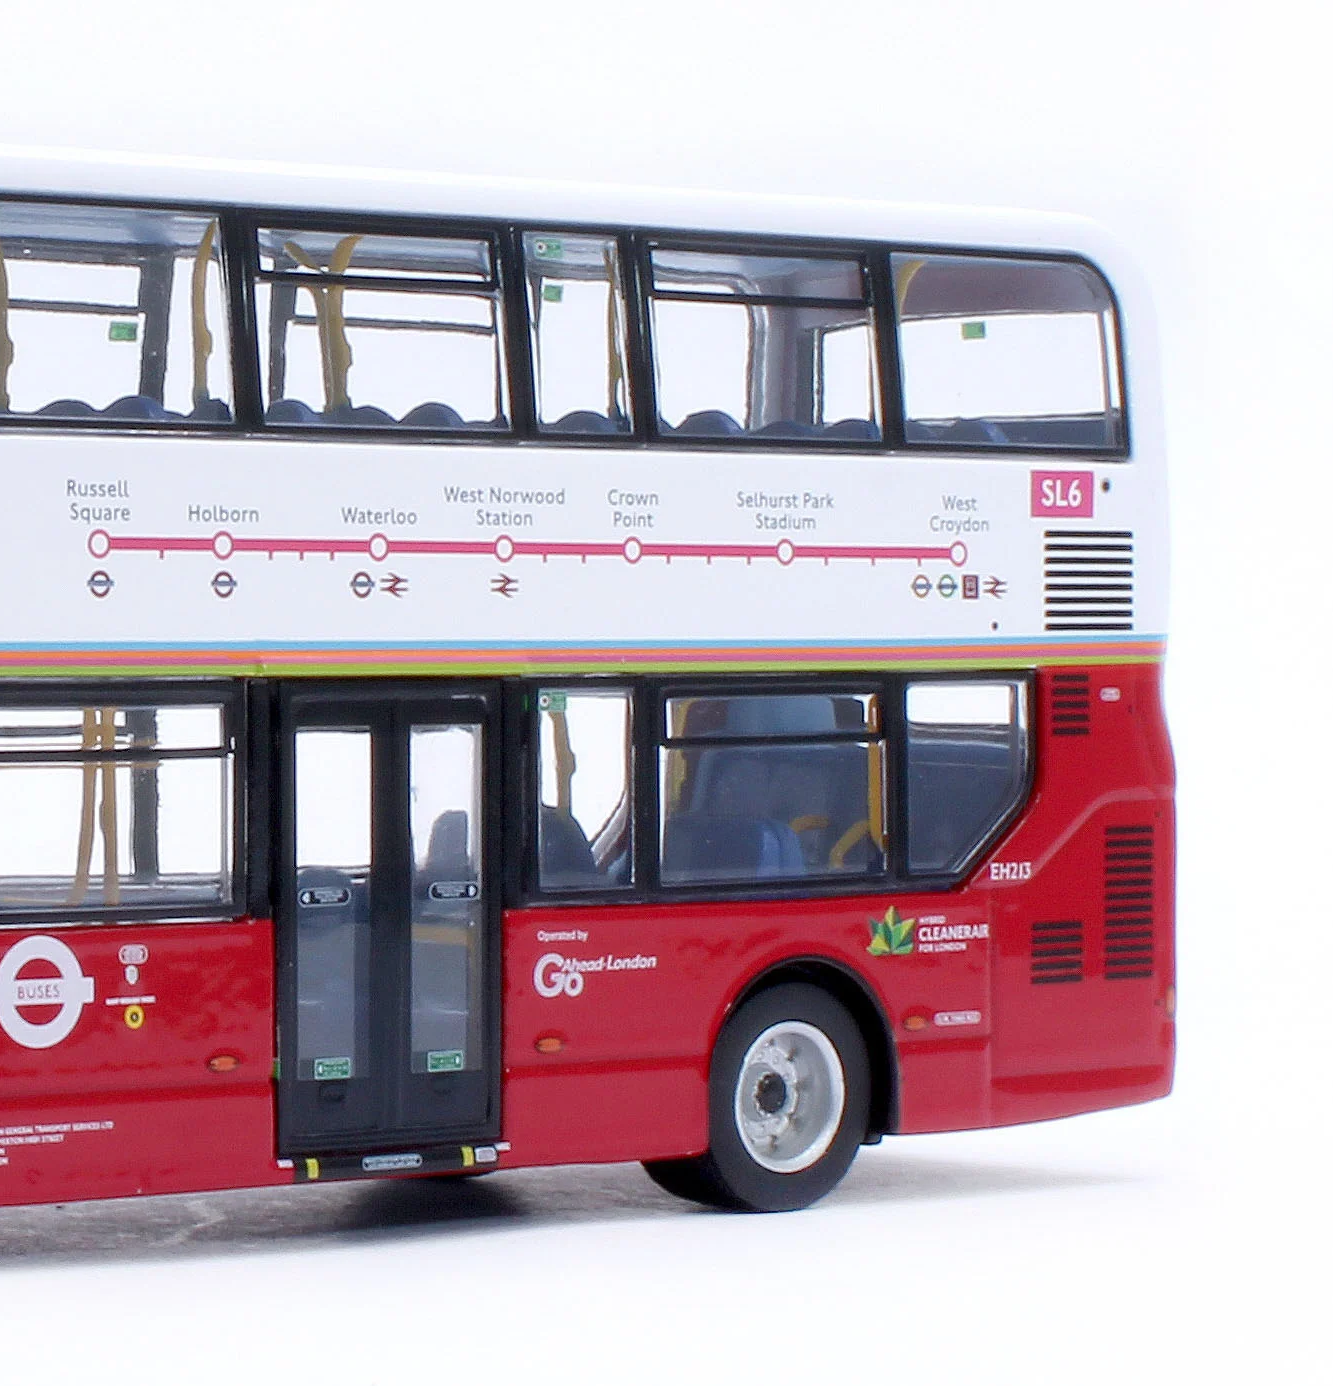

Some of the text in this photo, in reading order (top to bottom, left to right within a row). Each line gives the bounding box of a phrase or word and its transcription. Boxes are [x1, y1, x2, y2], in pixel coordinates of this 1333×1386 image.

[66, 480, 129, 498] Russell
[444, 486, 565, 505] West Norwood
[1041, 479, 1083, 508] SL6
[608, 490, 659, 508] Crown
[737, 491, 834, 509] Selhurst Park
[942, 495, 977, 512] West
[70, 504, 131, 523] Square
[188, 504, 259, 523] Holborn
[341, 507, 417, 525] Waterloo
[476, 509, 533, 527] Station
[613, 511, 653, 529] Point
[755, 513, 816, 530] Stadium
[929, 515, 990, 535] Croydon
[990, 862, 1031, 880] EH213
[537, 930, 589, 942] Operated by
[534, 953, 584, 998] Go
[17, 985, 61, 1000] BUSES
